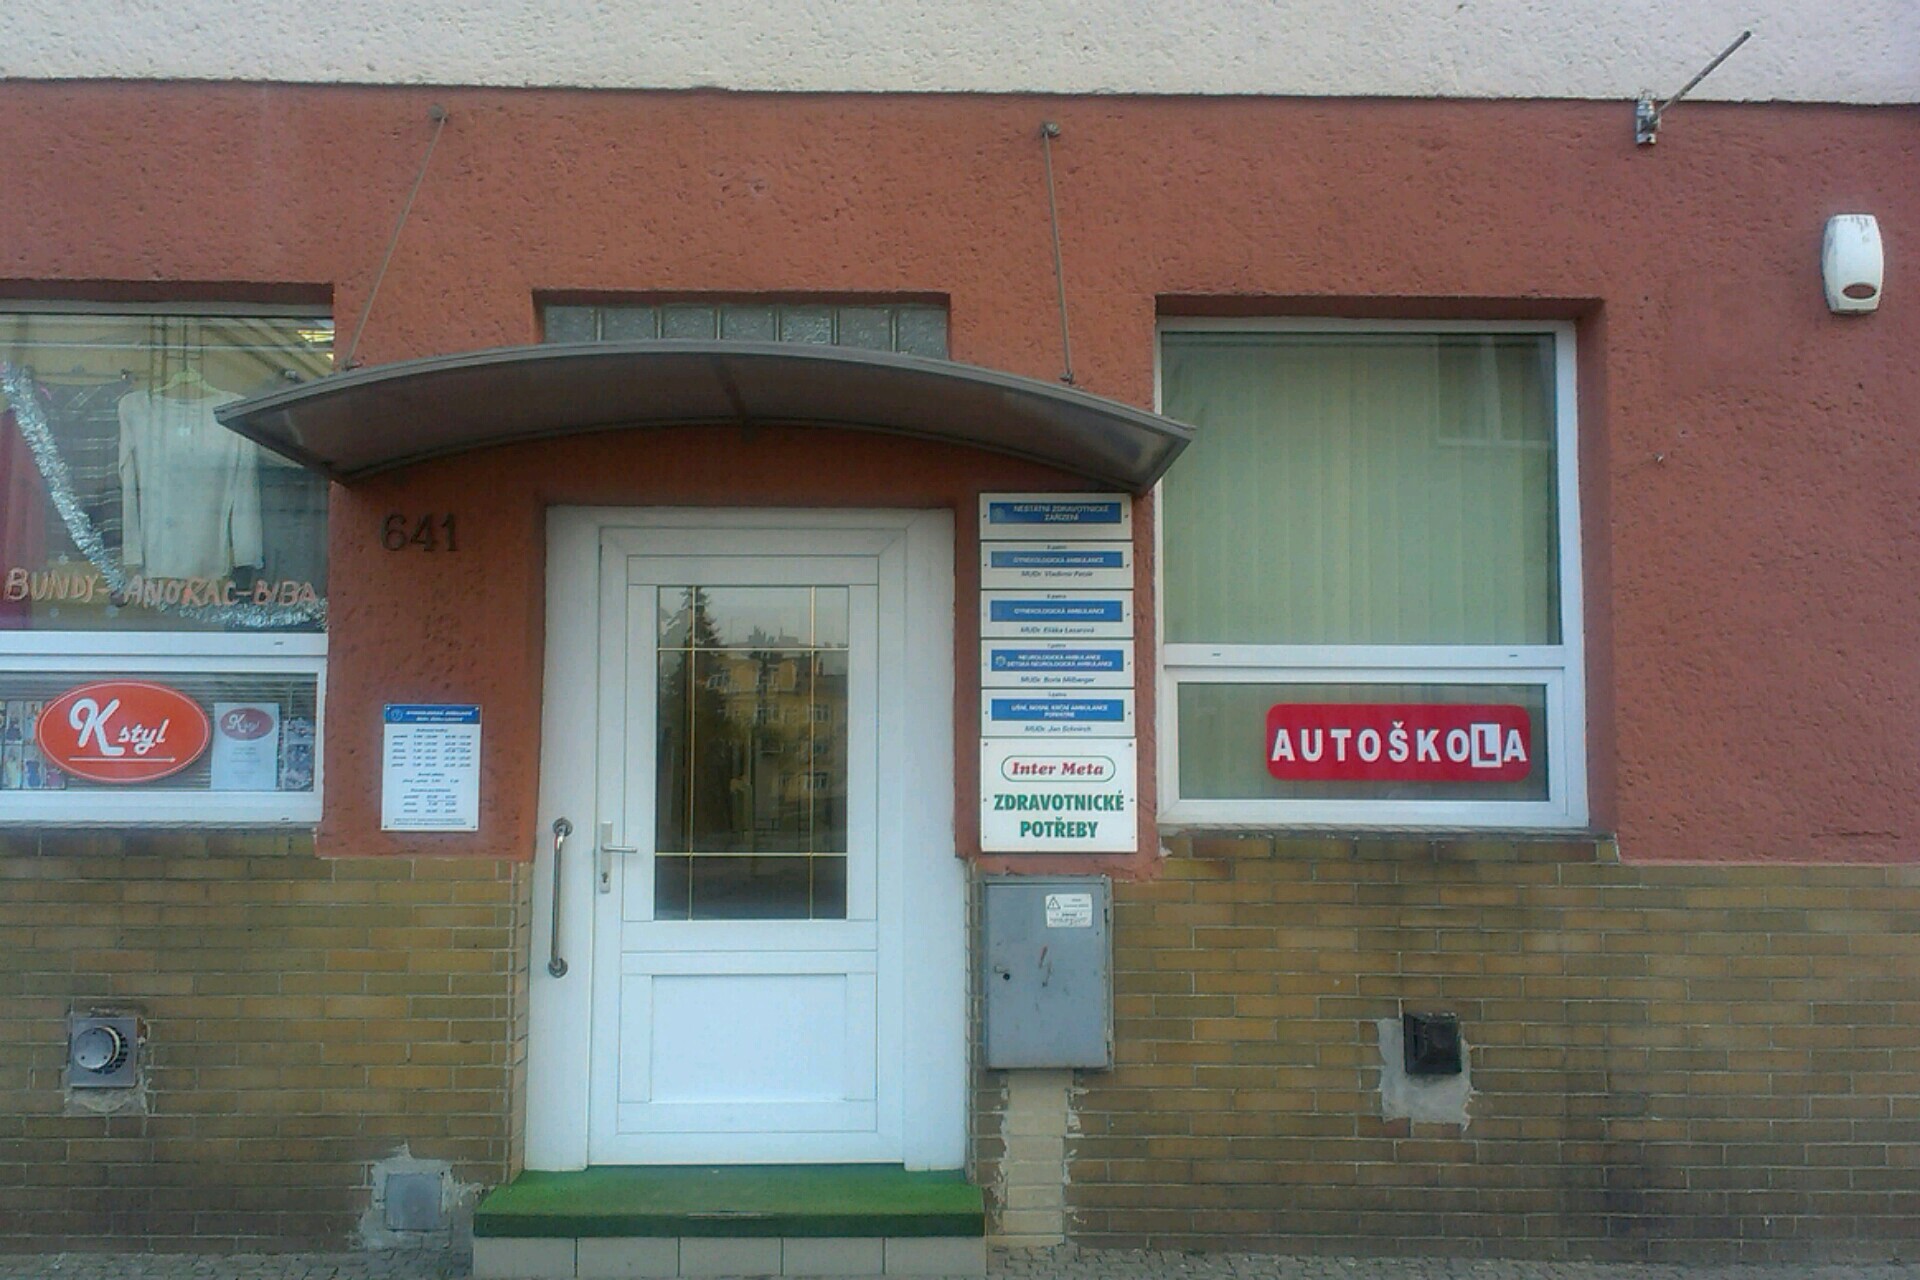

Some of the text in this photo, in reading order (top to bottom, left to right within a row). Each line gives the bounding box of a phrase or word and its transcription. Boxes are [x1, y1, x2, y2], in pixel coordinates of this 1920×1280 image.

[380, 512, 459, 552] 641
[69, 698, 170, 756] K styl
[1271, 721, 1527, 767] AUTOŠKOLA
[1012, 762, 1104, 775] Inter Meta
[994, 790, 1124, 811] ZDRAVOTNICKÉ
[1020, 816, 1098, 838] POTŘEBY
